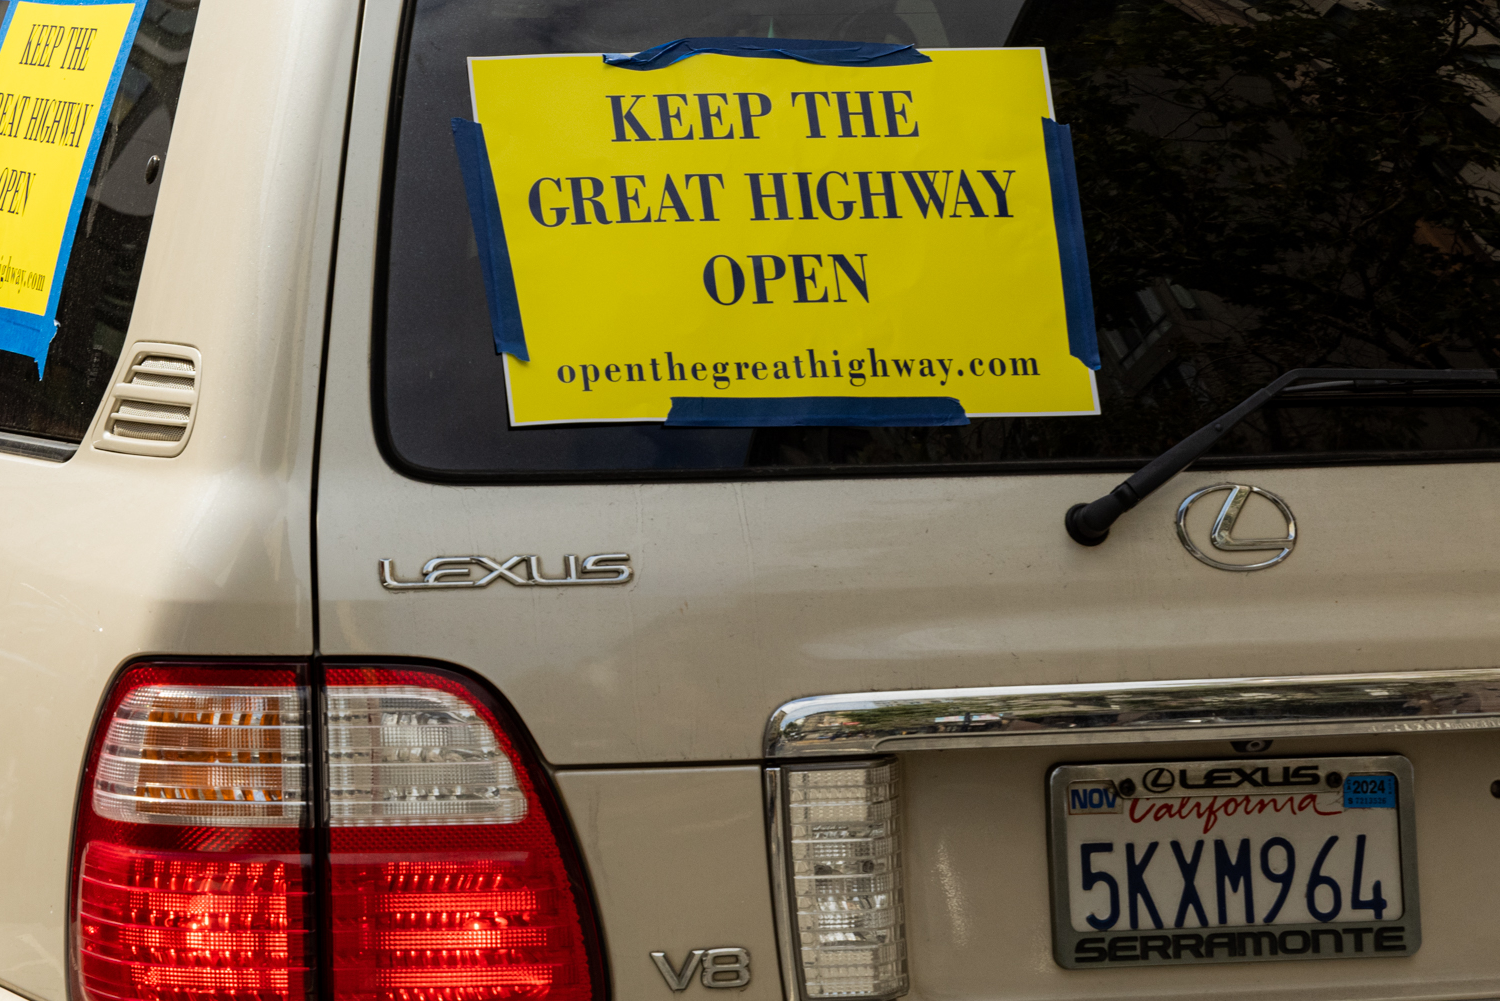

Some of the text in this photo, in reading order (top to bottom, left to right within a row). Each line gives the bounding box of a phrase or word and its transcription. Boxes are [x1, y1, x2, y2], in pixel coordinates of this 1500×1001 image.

[18, 24, 97, 71] KEEP THE
[23, 97, 94, 148] HIGHWAY
[605, 89, 920, 143] KEEP THE
[527, 168, 1017, 229] GREAT HIGHWAY
[702, 252, 871, 307] OPEN
[556, 346, 1041, 391] openthegreathighway.com
[378, 553, 635, 591] LEXUS
[1070, 788, 1118, 810] NOV
[1179, 765, 1322, 790] LEXUS
[1352, 779, 1386, 794] 2024
[1128, 793, 1343, 834] California
[1080, 834, 1388, 931] 5KXM964
[1074, 926, 1407, 963] SERRAMONTE
[649, 946, 752, 992] V8
